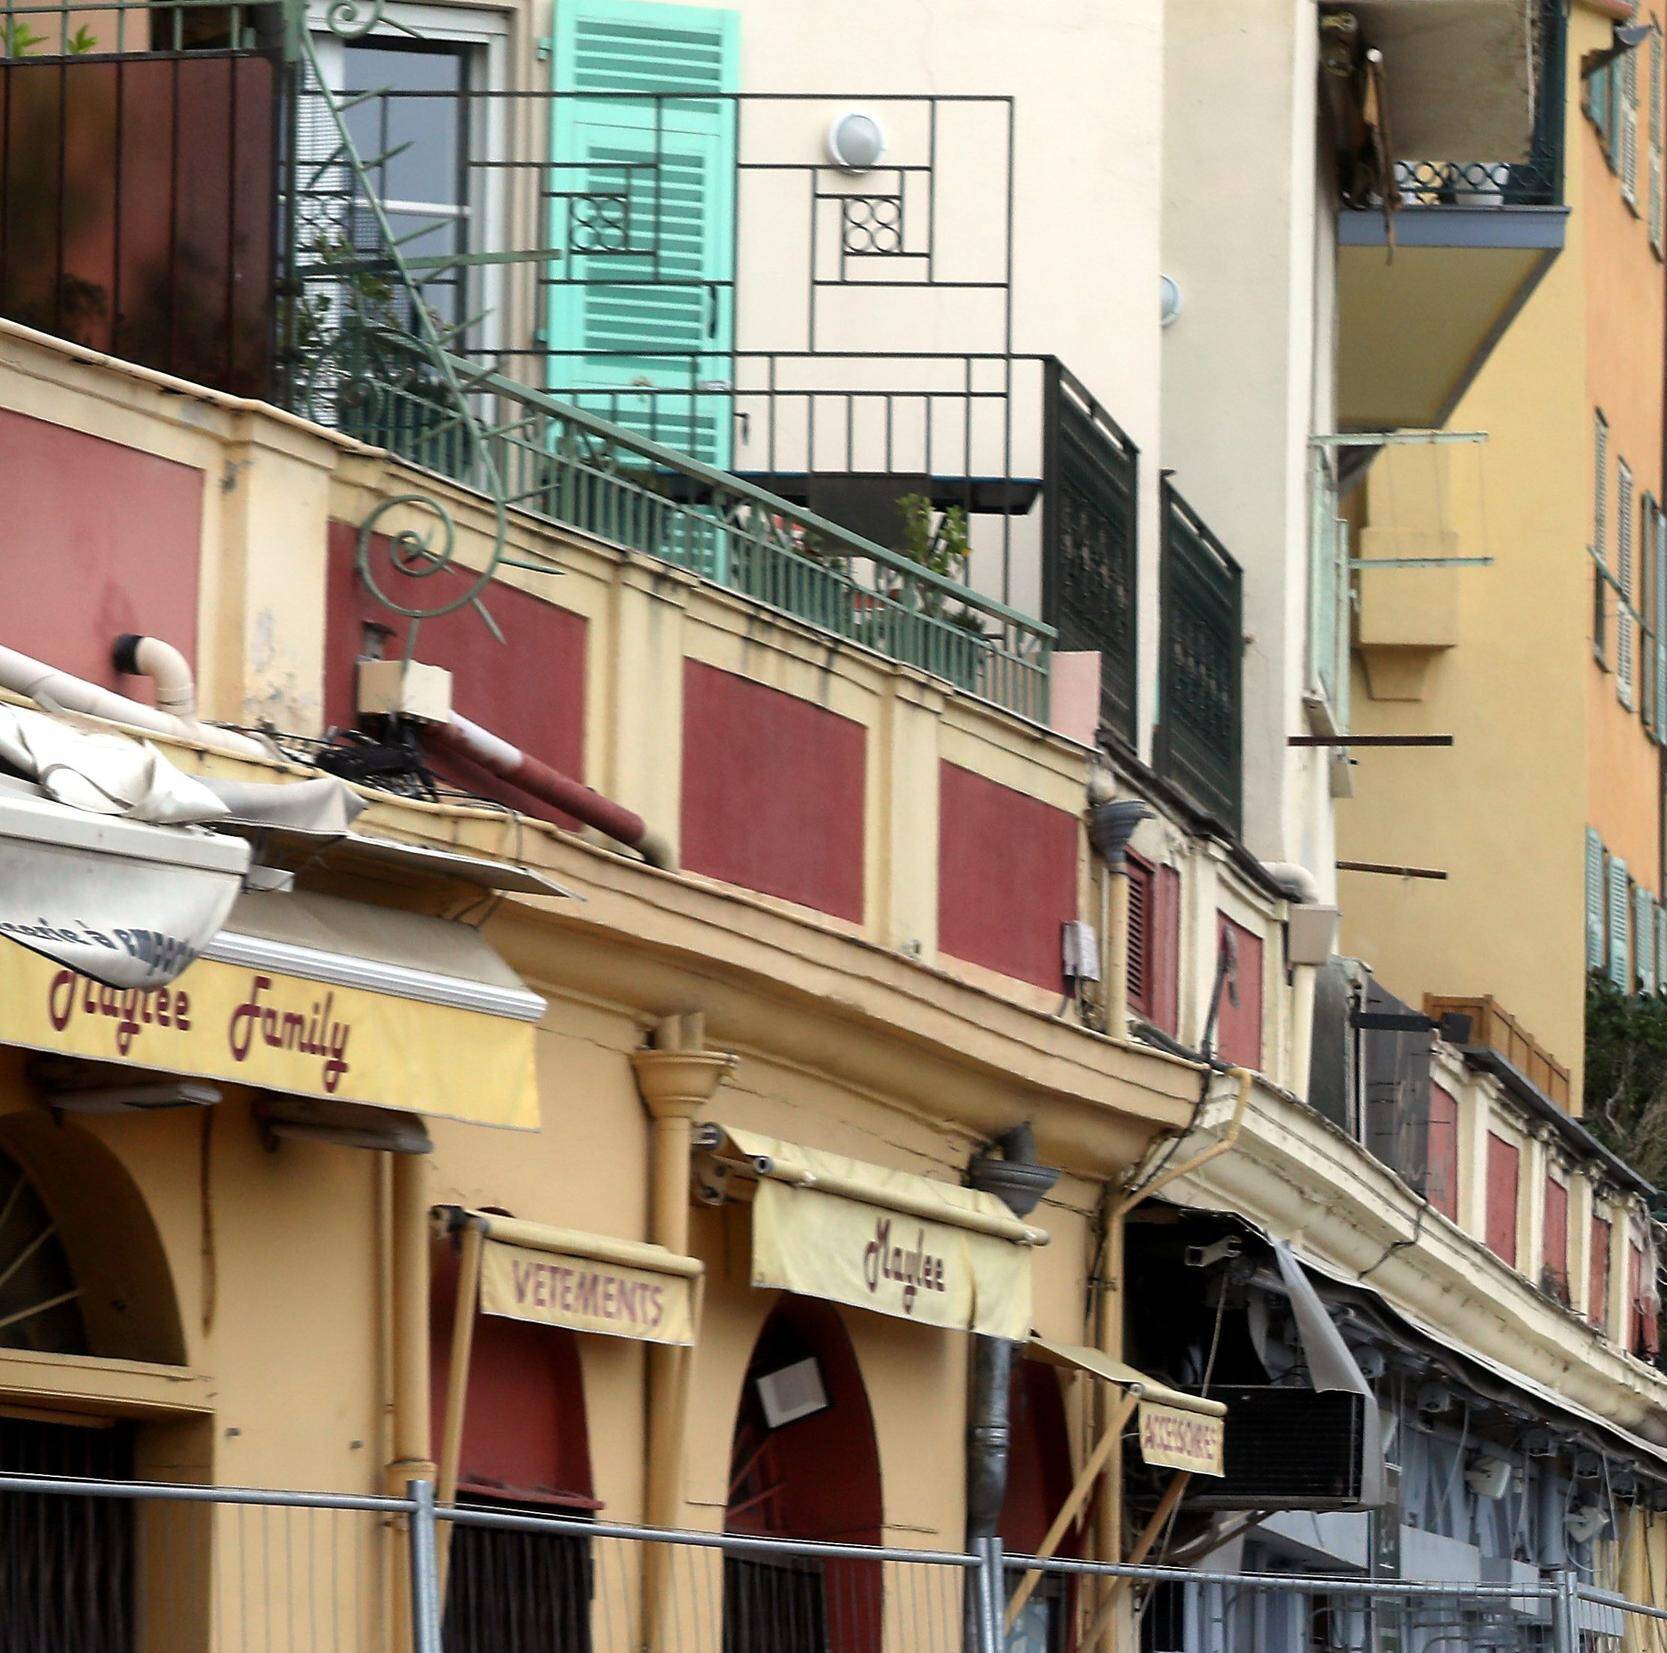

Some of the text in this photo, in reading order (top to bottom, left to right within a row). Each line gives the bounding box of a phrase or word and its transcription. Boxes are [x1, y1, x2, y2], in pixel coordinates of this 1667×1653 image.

[228, 975, 350, 1093] Family
[512, 1259, 666, 1328] VETEMENTS
[863, 1217, 945, 1315] Maylee
